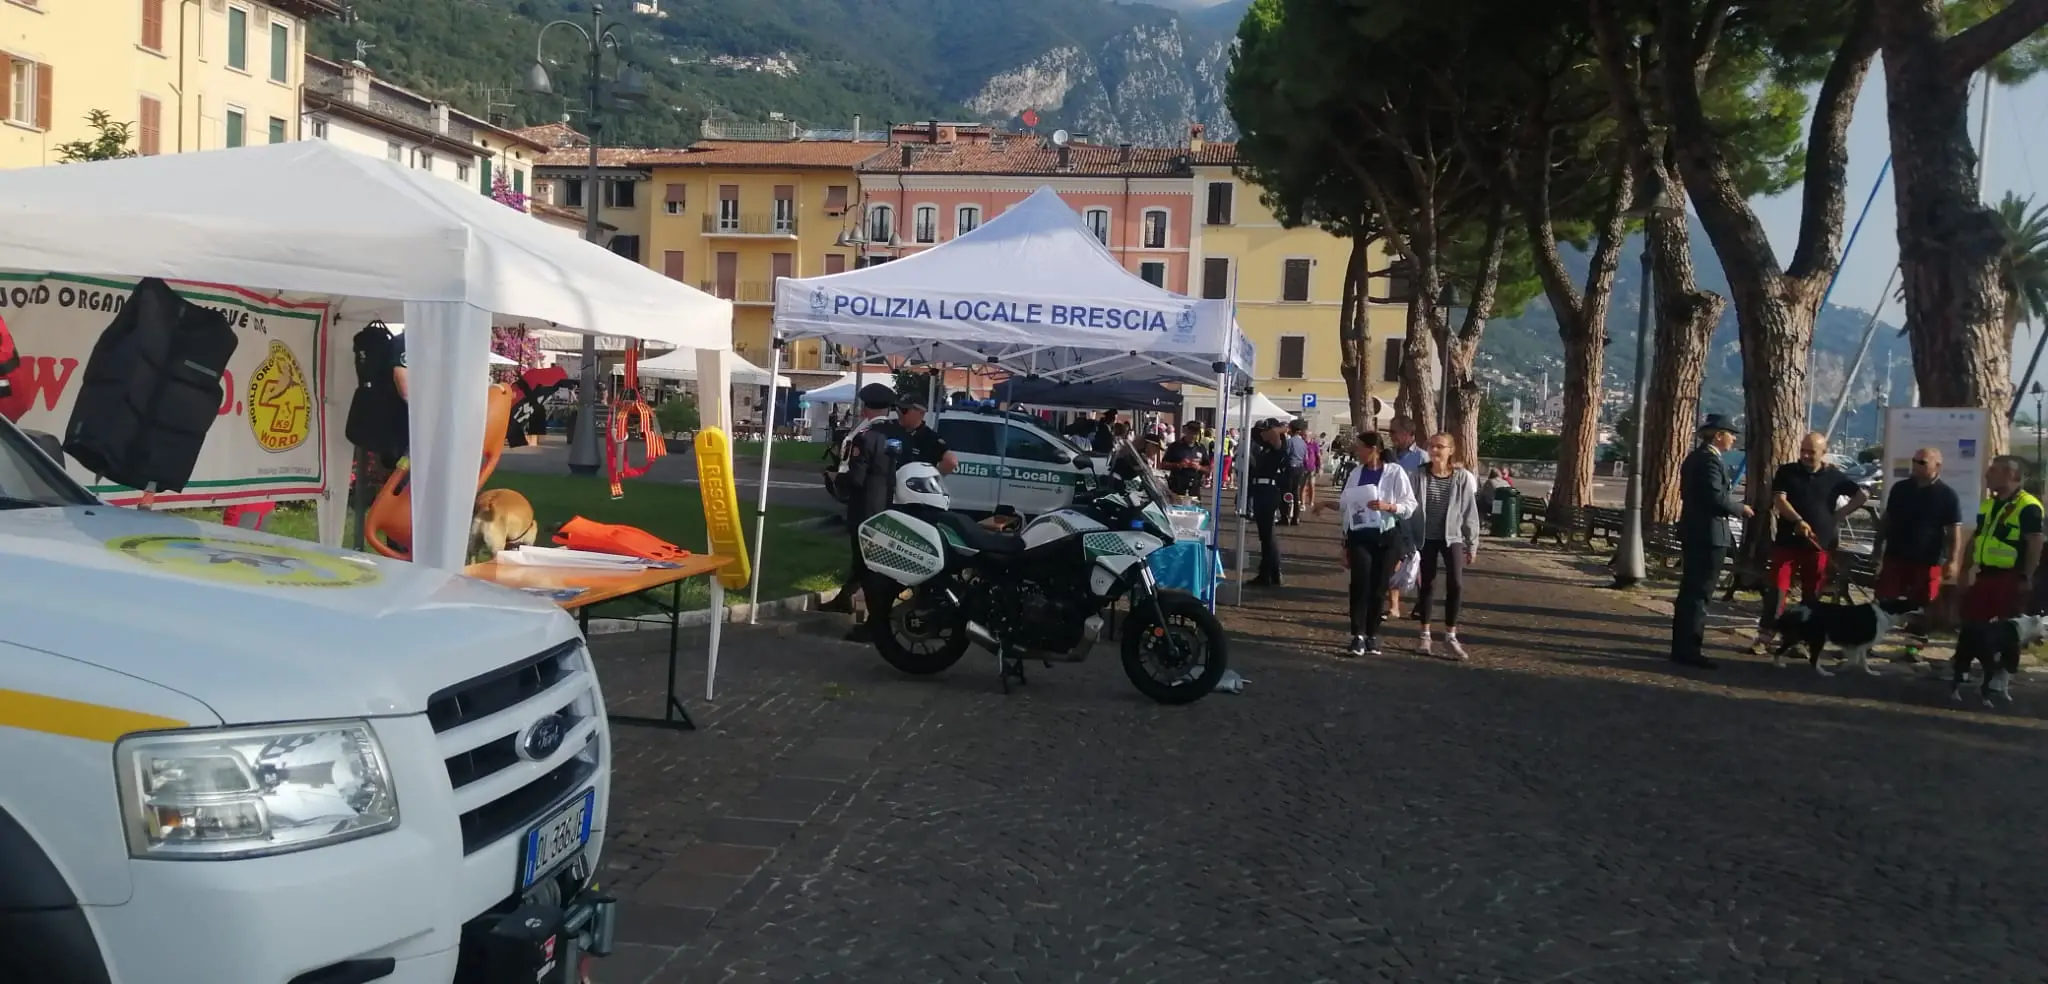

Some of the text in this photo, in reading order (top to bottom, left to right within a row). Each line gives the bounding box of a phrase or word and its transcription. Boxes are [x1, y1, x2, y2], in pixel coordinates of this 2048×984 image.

[834, 295, 931, 319] POLIZIA
[940, 300, 1043, 323] LOCALE
[1051, 304, 1167, 332] BRESCIA
[1305, 395, 1315, 407] P
[261, 430, 299, 448] WORD
[952, 463, 1061, 483] olizia Locale
[706, 464, 729, 532] RESCUE
[874, 523, 933, 554] Polizia Locale
[896, 544, 924, 561] Brescia
